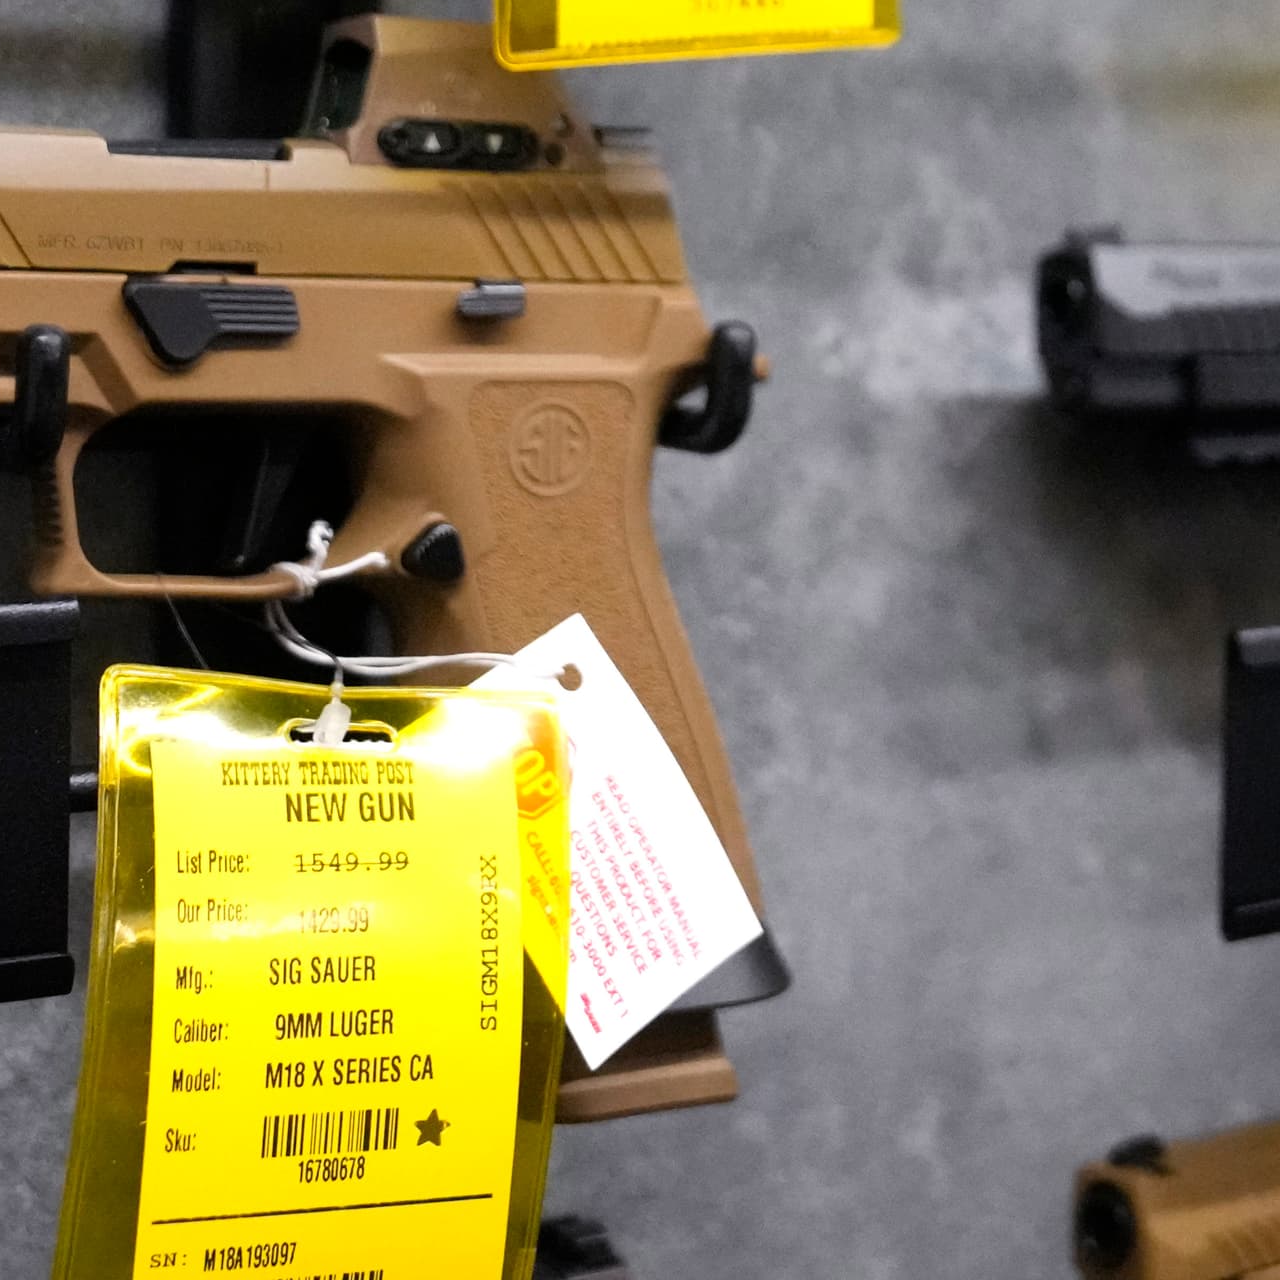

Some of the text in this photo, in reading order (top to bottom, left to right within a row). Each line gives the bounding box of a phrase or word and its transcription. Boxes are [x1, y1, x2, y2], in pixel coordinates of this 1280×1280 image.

[221, 760, 415, 786] KITTERY TRADING POST
[514, 749, 561, 797] OP
[285, 791, 416, 822] NEW GUN
[177, 849, 410, 874] List Price: 1549.99
[570, 829, 649, 975] CUSTOMER SERVICE
[587, 819, 610, 855] THIS
[641, 928, 663, 963] FOR
[629, 860, 664, 918] BEFORE
[177, 897, 370, 934] Our Price: 1429.99
[569, 870, 618, 958] QUESTIONS
[479, 854, 499, 1032] SIGM18X9RX
[175, 965, 215, 995] Mfg.:
[269, 954, 376, 986] SIG SAUER
[603, 976, 624, 1006] EXT
[173, 1017, 230, 1044] Caliber:
[275, 1008, 395, 1041] 9MM LUGER
[171, 1066, 222, 1093] Model:
[264, 1053, 435, 1089] M18 X SERIES CA
[164, 1127, 198, 1154] Sku:
[297, 1156, 366, 1184] 16780678
[149, 1241, 297, 1273] SN: M18A193097
